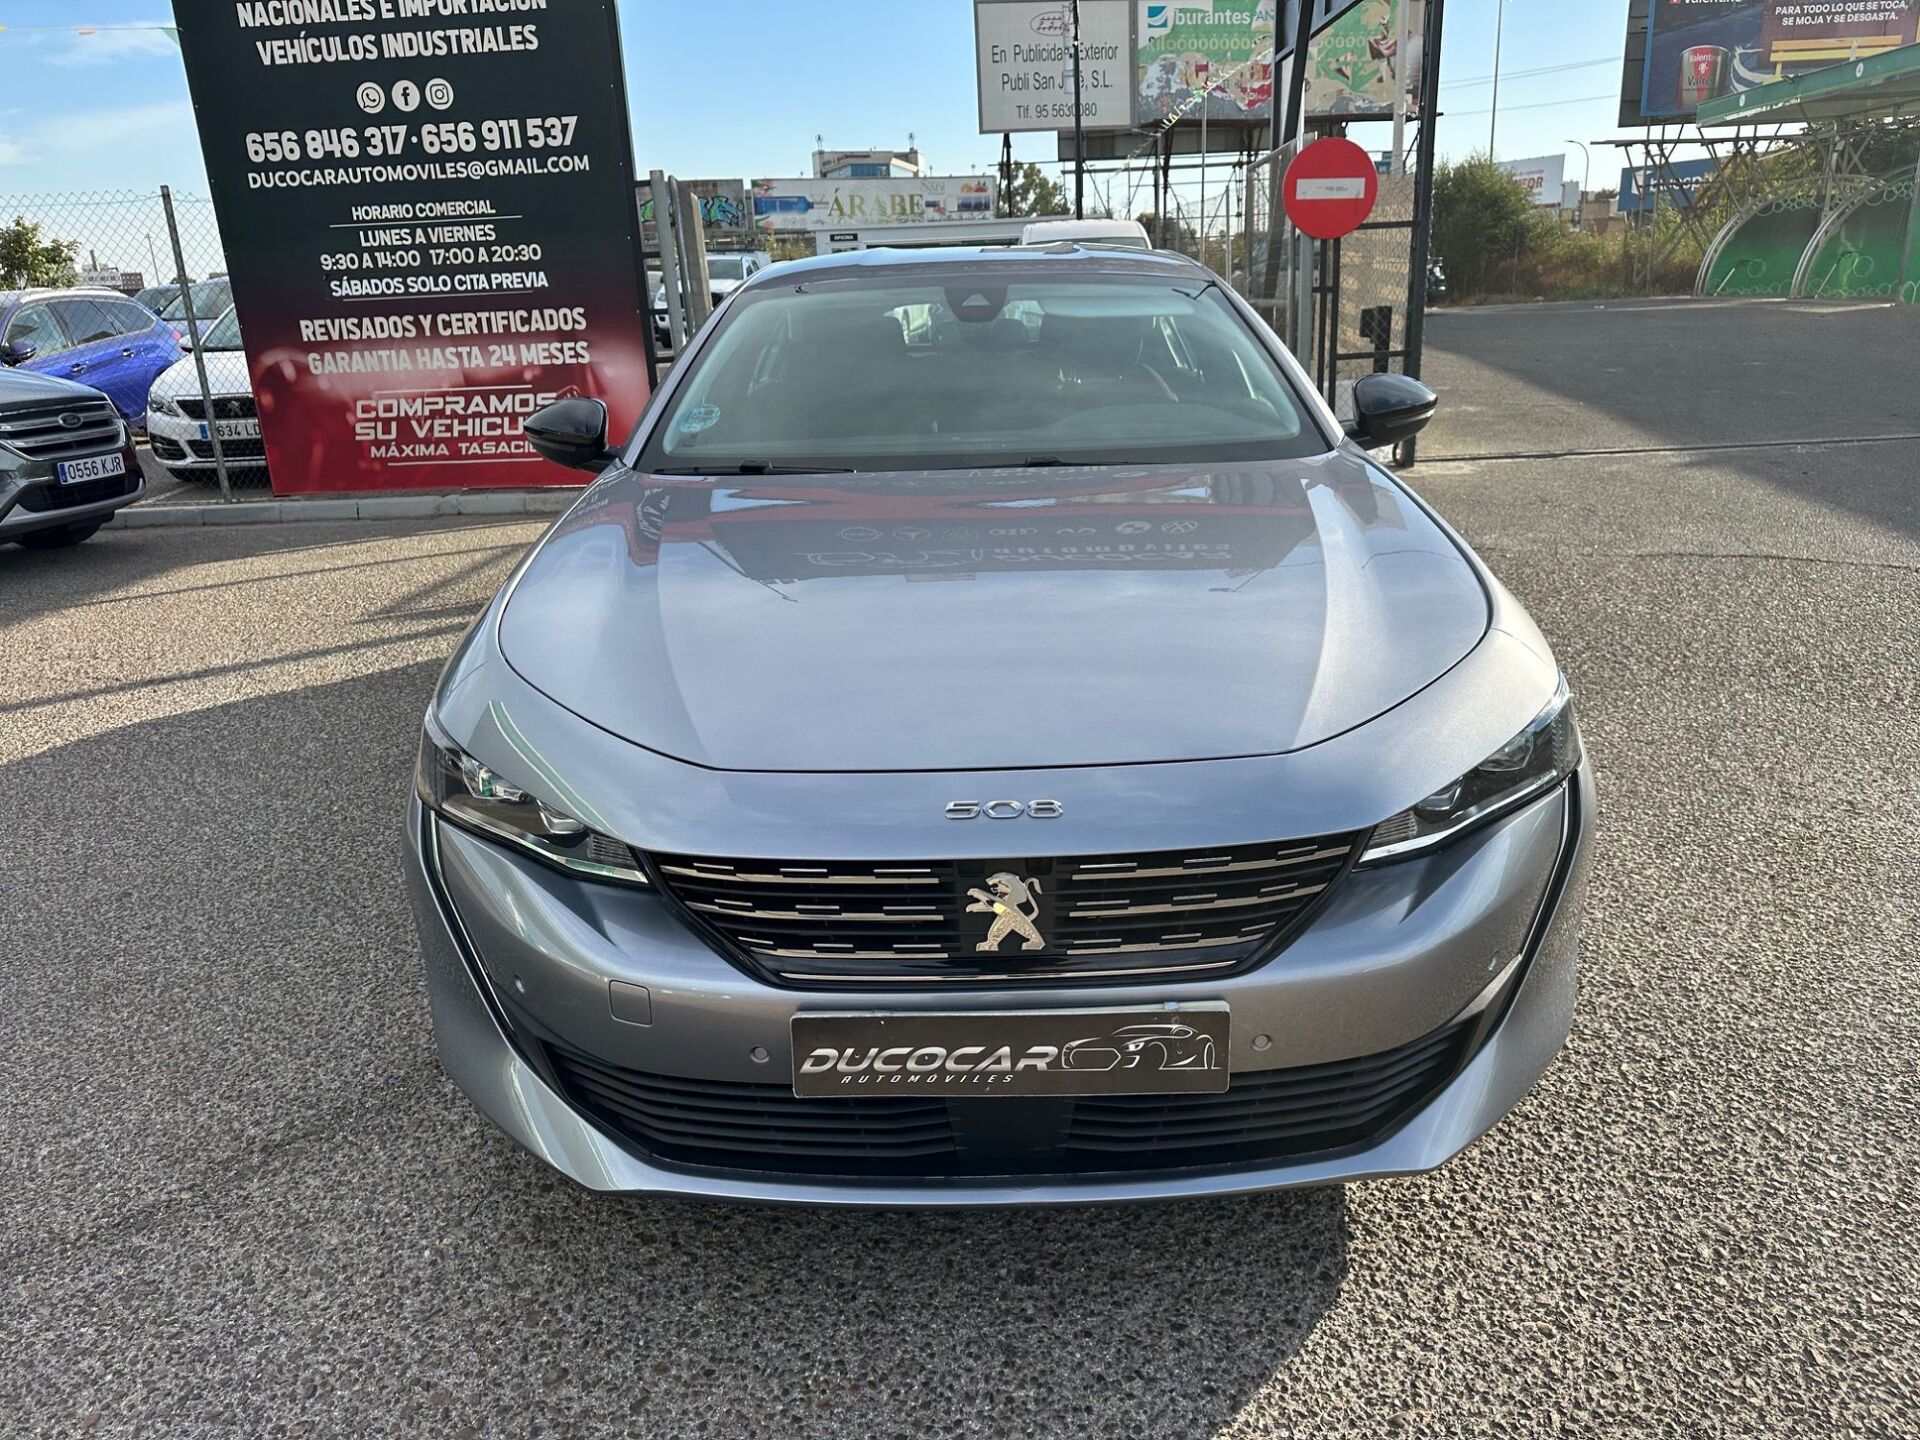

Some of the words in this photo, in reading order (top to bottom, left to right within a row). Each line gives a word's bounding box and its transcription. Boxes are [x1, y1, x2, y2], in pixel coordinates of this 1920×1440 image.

[236, 0, 376, 28] NACIONALES
[379, 0, 395, 19] E
[1175, 10, 1251, 26] burantes
[1775, 6, 1801, 15] PARA
[1803, 5, 1830, 14] TODO
[1831, 4, 1844, 13] LO
[1845, 2, 1865, 12] QUE
[1865, 2, 1878, 10] SE
[1880, 0, 1909, 11] TOCA,
[1782, 17, 1794, 26] SE
[1795, 16, 1824, 26] MOJA
[1825, 14, 1833, 24] Y
[1833, 14, 1846, 23] SE
[1847, 12, 1899, 23] DESGASTA.
[256, 31, 378, 66] VEHÍCULOS
[381, 24, 539, 59] INDUSTRIALES
[991, 45, 1007, 63] En
[1079, 42, 1119, 61] Exterior
[1001, 72, 1030, 91] Publi
[1033, 71, 1055, 90] San
[1091, 69, 1113, 89] S.L.
[1016, 104, 1032, 119] Tlf.
[1035, 104, 1049, 119] 95
[245, 130, 301, 163] 656
[304, 127, 360, 160] 846
[364, 124, 407, 157] 317
[421, 121, 476, 155] 656
[481, 119, 522, 151] 911
[526, 115, 578, 148] 537
[248, 154, 590, 189] DUCOCARAUTOMOVILES@GMAIL.COM
[351, 203, 414, 221] HORARIO
[415, 200, 496, 218] COMERCIAL
[360, 228, 412, 247] LUNES
[415, 228, 427, 244] A
[427, 224, 496, 243] VIERNES
[320, 252, 359, 271] 9:30
[362, 252, 374, 269] A
[374, 249, 421, 268] 14:00
[429, 246, 475, 265] 17:00
[478, 246, 489, 263] A
[491, 243, 542, 262] 20:30
[330, 276, 405, 297] SÁBADOS
[407, 275, 451, 293] SOLO
[454, 273, 490, 291] CITA
[491, 271, 549, 289] PREVIA
[300, 314, 417, 341] REVISADOS
[418, 314, 432, 337] Y
[437, 306, 587, 336] CERTIFICADOS
[307, 348, 413, 375] GARANTIA
[415, 346, 485, 370] HASTA
[488, 344, 517, 367] 24
[520, 341, 591, 366] MESES
[216, 424, 242, 437] 634
[245, 422, 261, 436] LD
[355, 421, 397, 441] SU
[410, 416, 528, 438] VEHICU
[370, 441, 450, 458] MÁXIMA
[67, 461, 99, 480] 0556
[100, 456, 123, 475] KJR
[944, 799, 1064, 820] 508
[799, 1045, 1059, 1074] DUCOCAR
[840, 1074, 1014, 1085] AUTOMÓVILES
